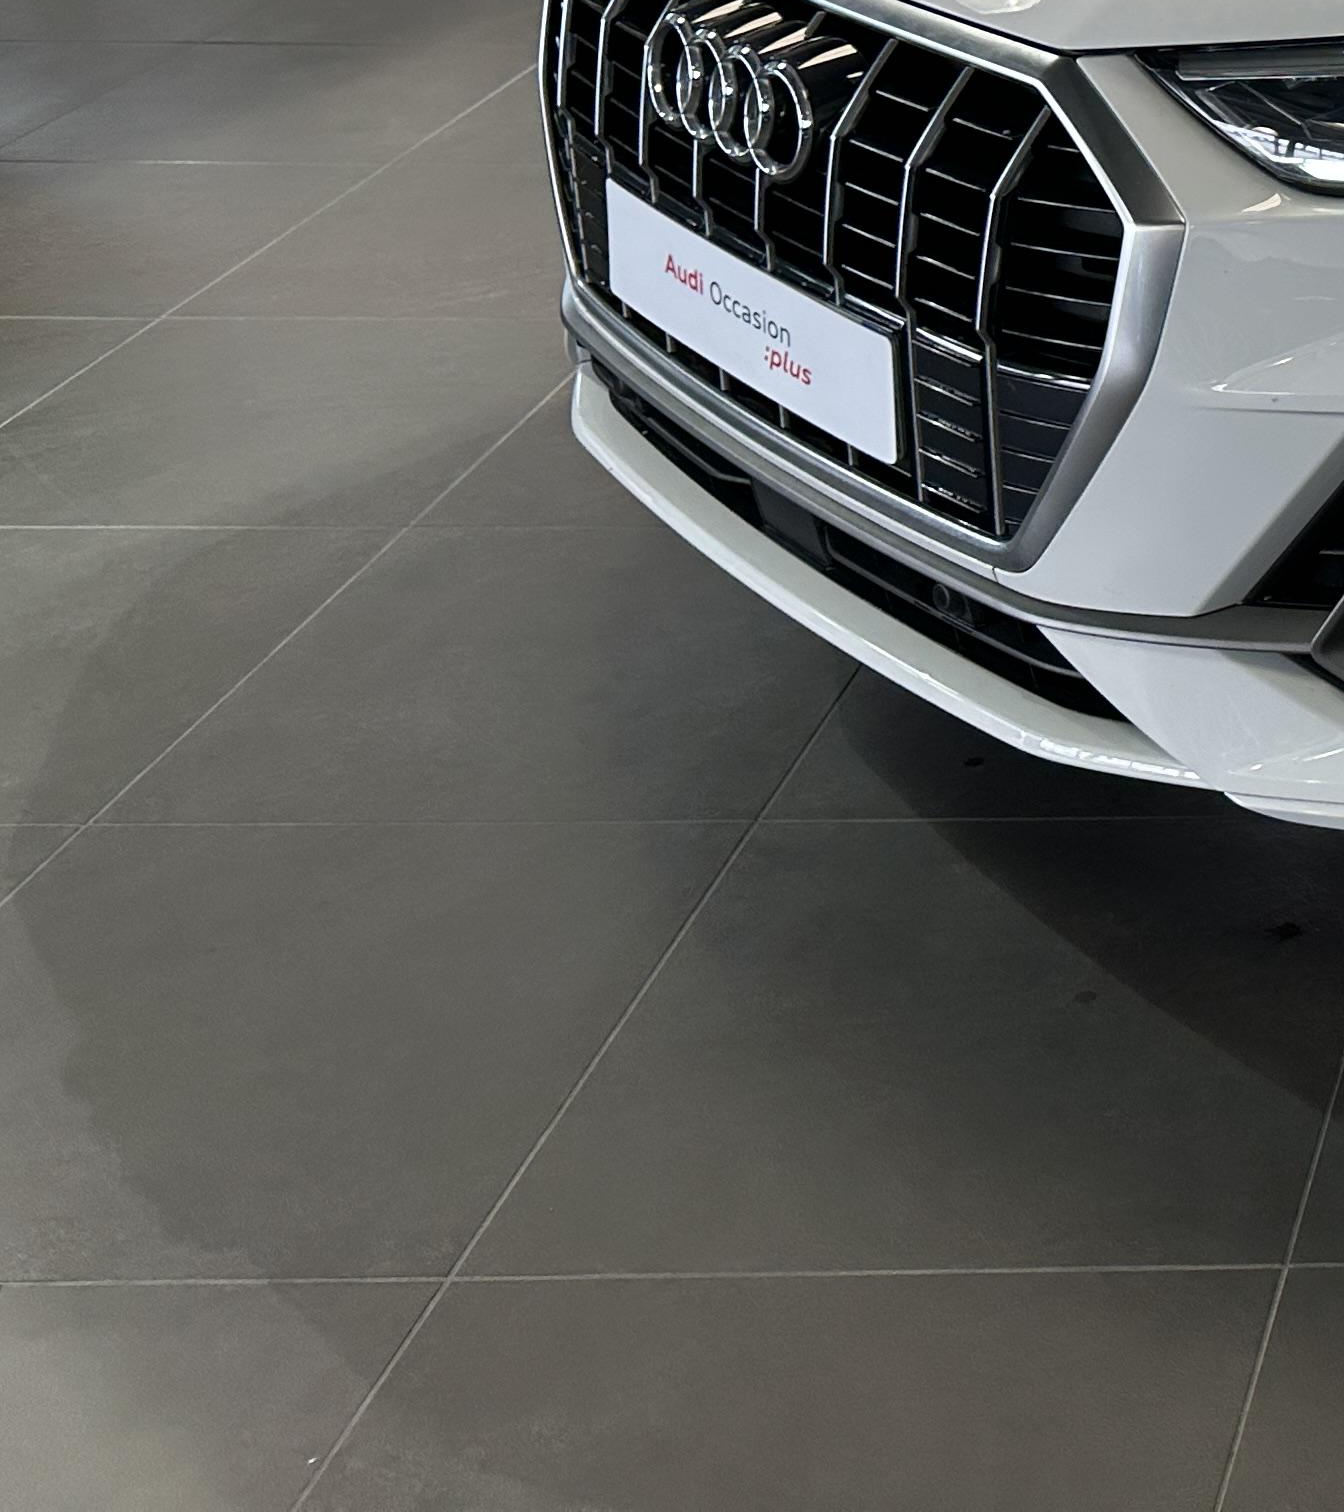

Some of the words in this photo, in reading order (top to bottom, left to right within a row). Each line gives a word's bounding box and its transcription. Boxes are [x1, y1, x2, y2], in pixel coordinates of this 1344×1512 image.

[664, 254, 704, 296] Audi
[709, 281, 791, 348] Occasion
[764, 345, 813, 386] :plus
